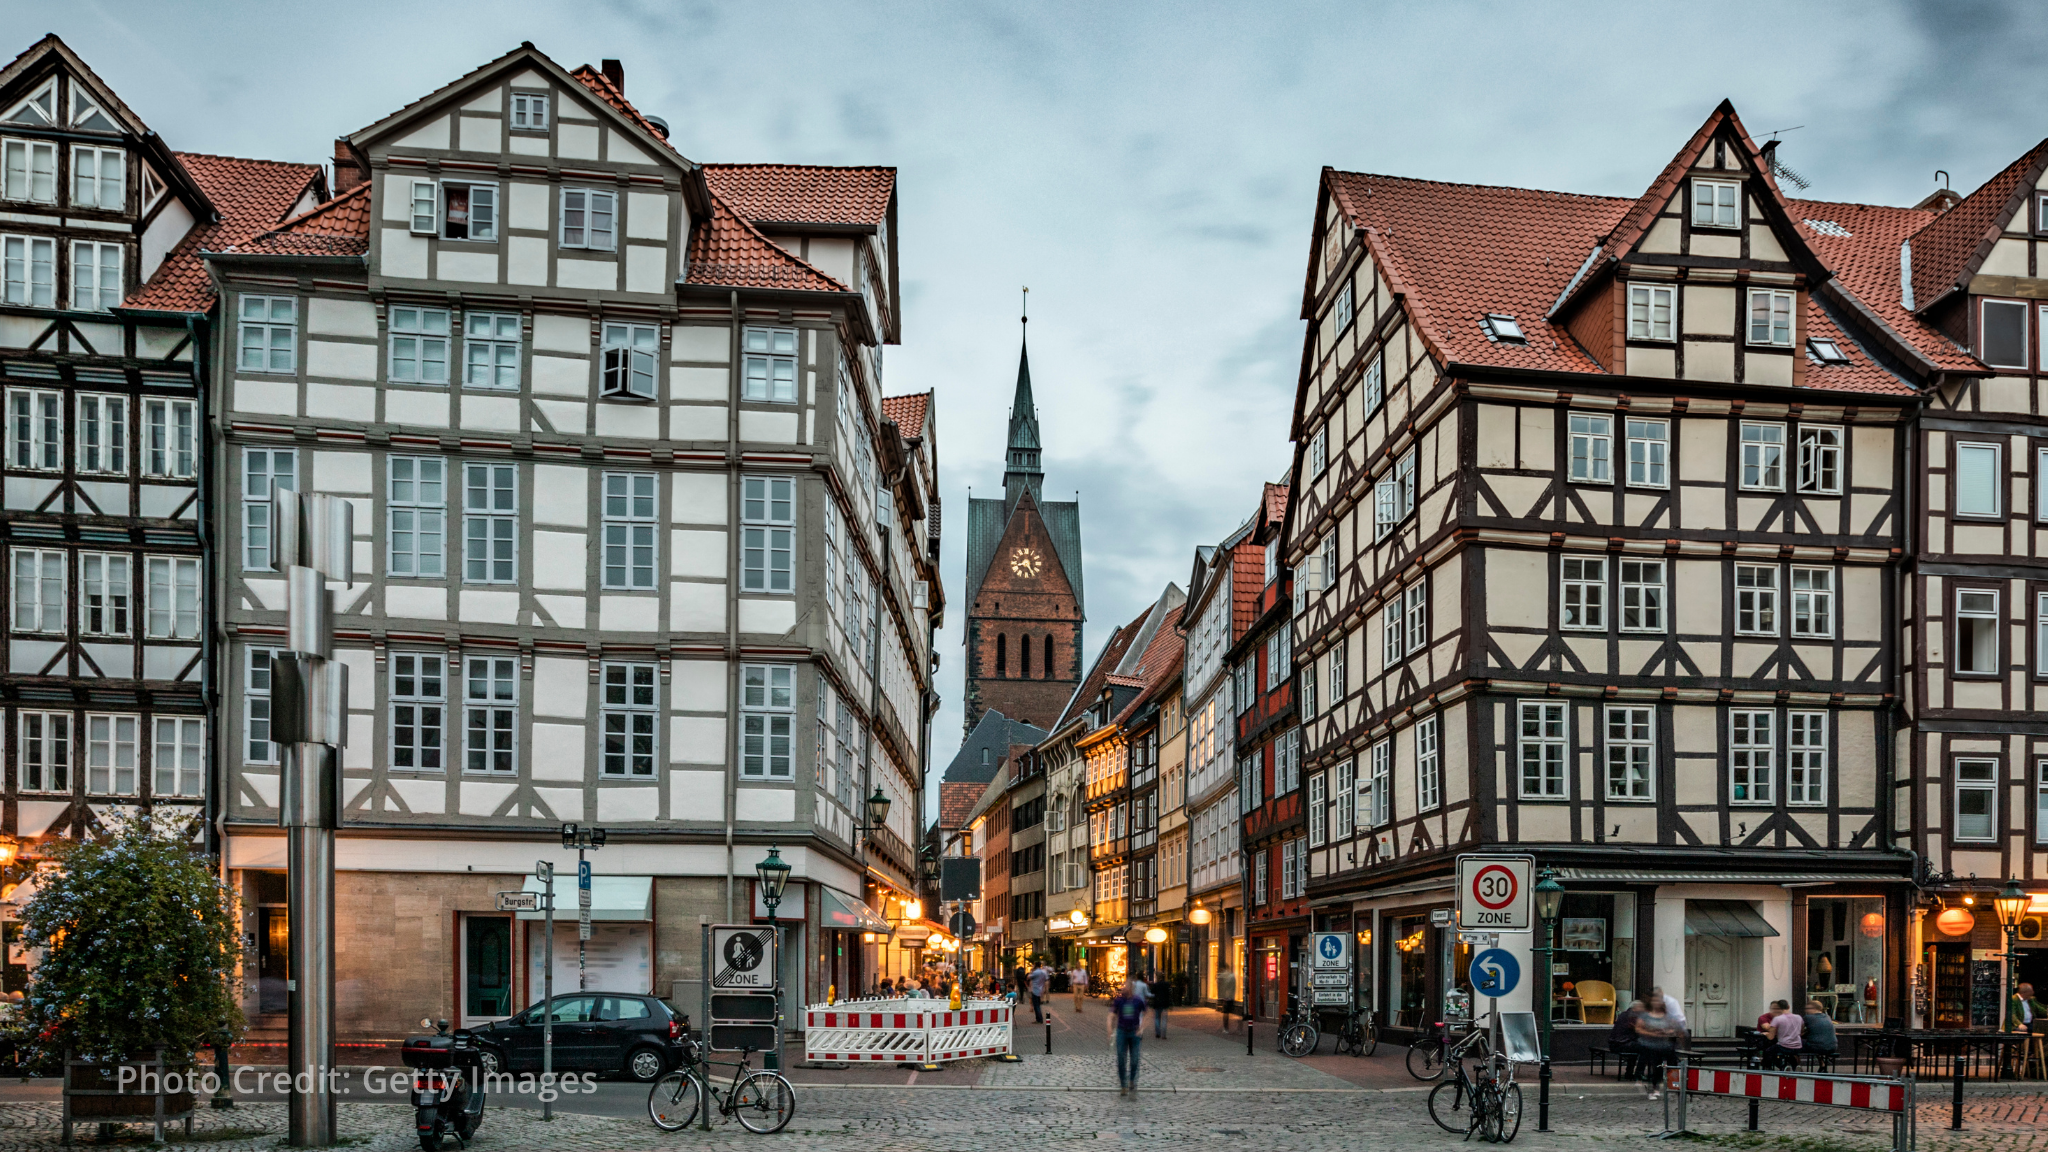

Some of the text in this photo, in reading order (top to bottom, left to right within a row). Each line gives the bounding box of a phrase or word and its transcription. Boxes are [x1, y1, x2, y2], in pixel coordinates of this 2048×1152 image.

[580, 864, 588, 885] P
[1482, 877, 1508, 897] 30
[505, 897, 534, 907] Burgstr.
[1477, 912, 1512, 923] ZONE
[728, 975, 759, 984] ZONE
